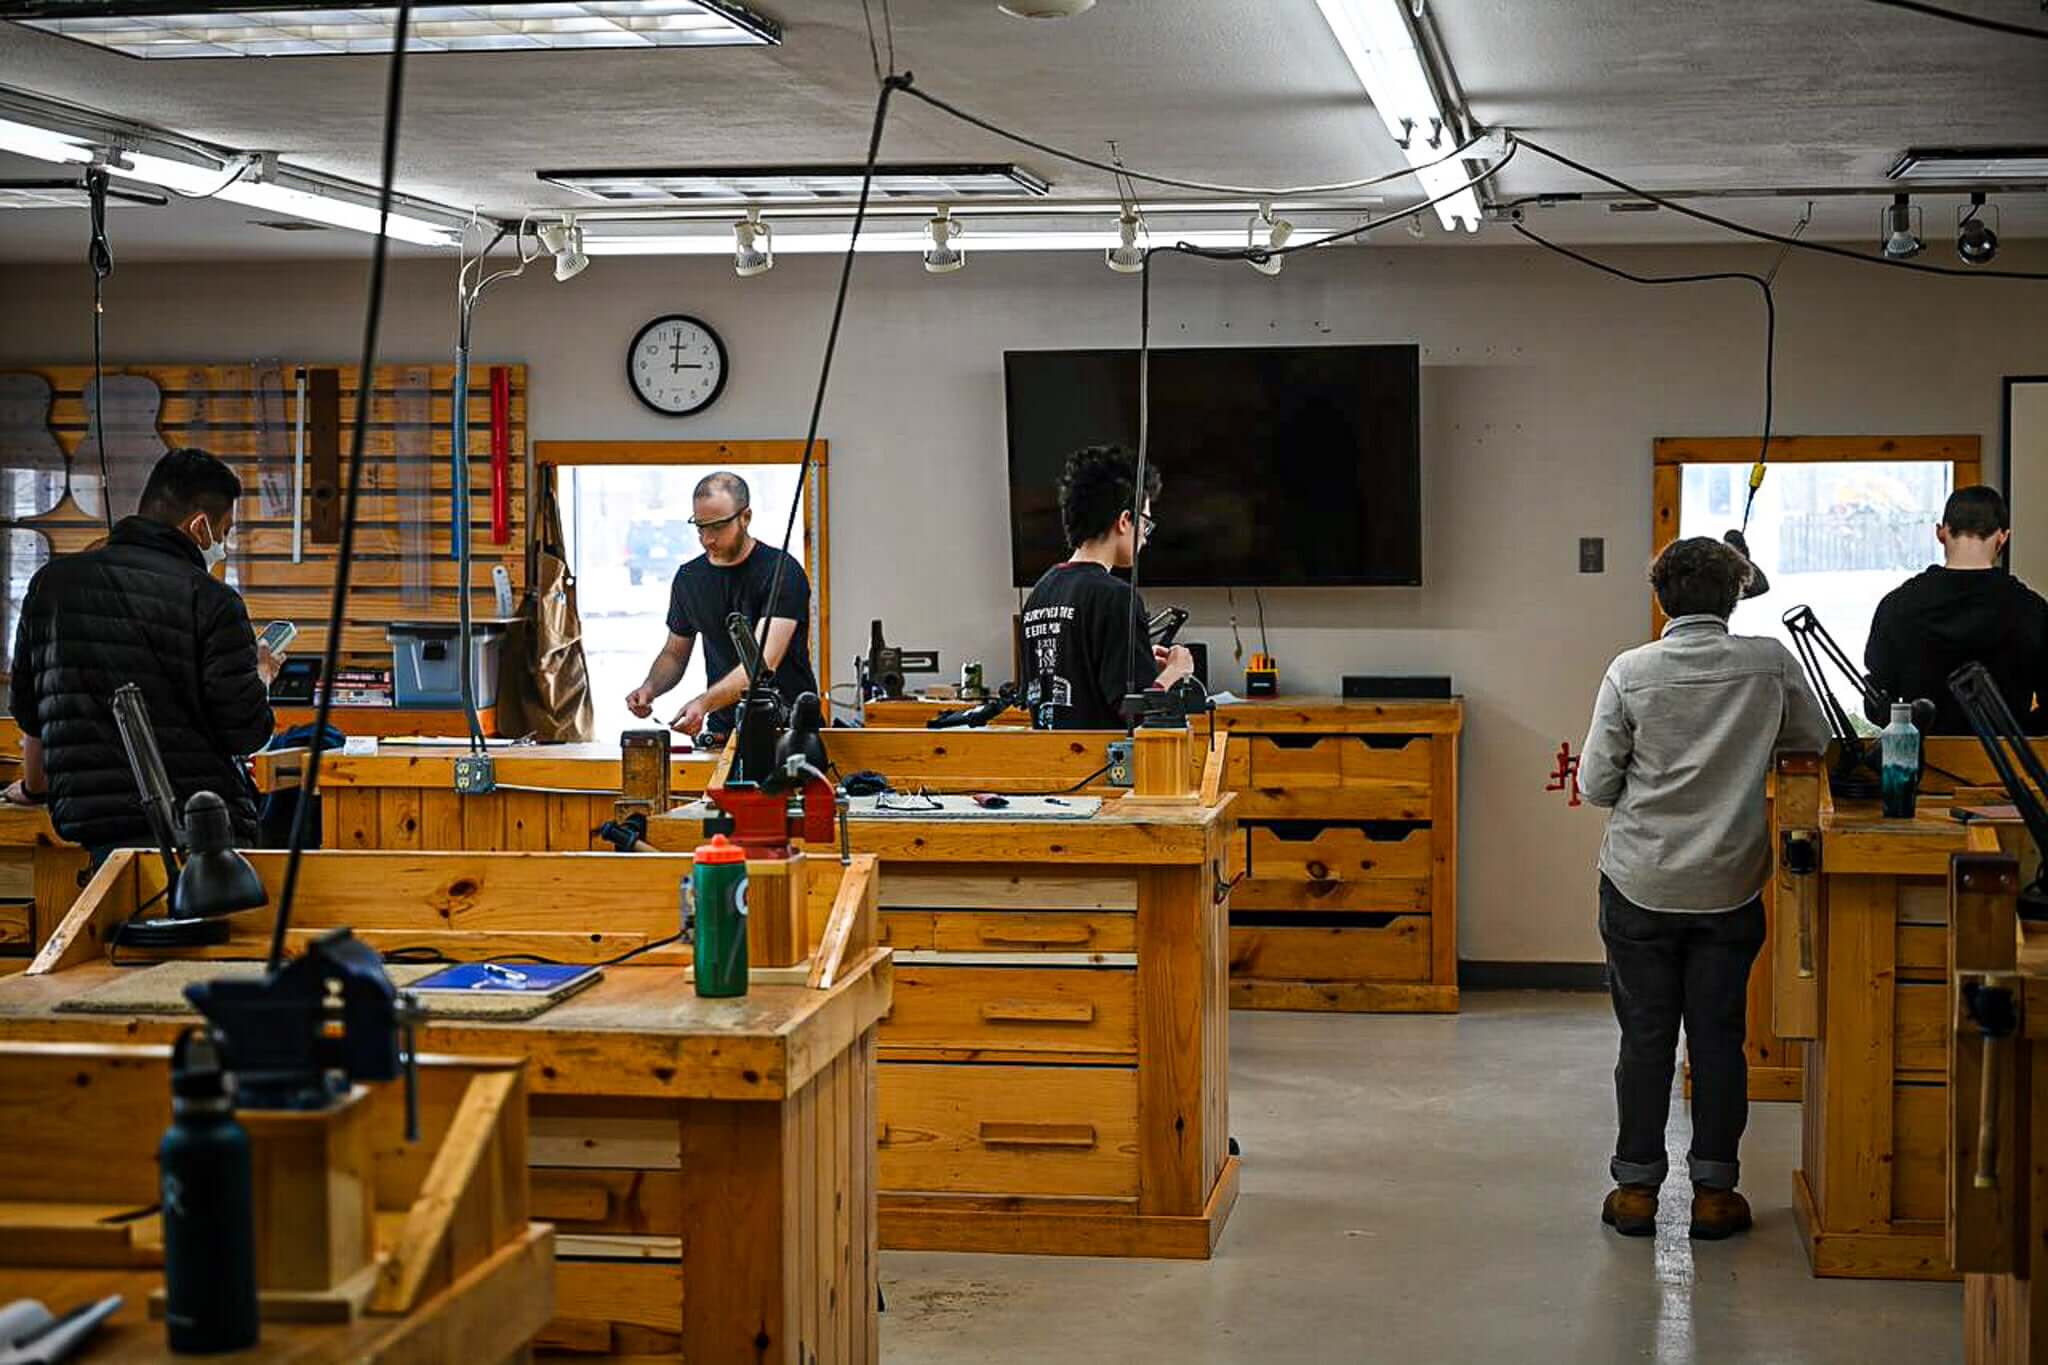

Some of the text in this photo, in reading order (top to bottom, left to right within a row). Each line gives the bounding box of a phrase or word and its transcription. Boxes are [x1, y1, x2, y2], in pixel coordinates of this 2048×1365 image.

[658, 331, 667, 342] 11
[647, 345, 658, 355] 10
[703, 345, 710, 355] 2
[640, 360, 647, 370] 9
[707, 361, 714, 370] 3
[645, 377, 652, 386] 8
[702, 378, 709, 387] 4
[658, 389, 664, 398] 7
[674, 394, 681, 404] 6
